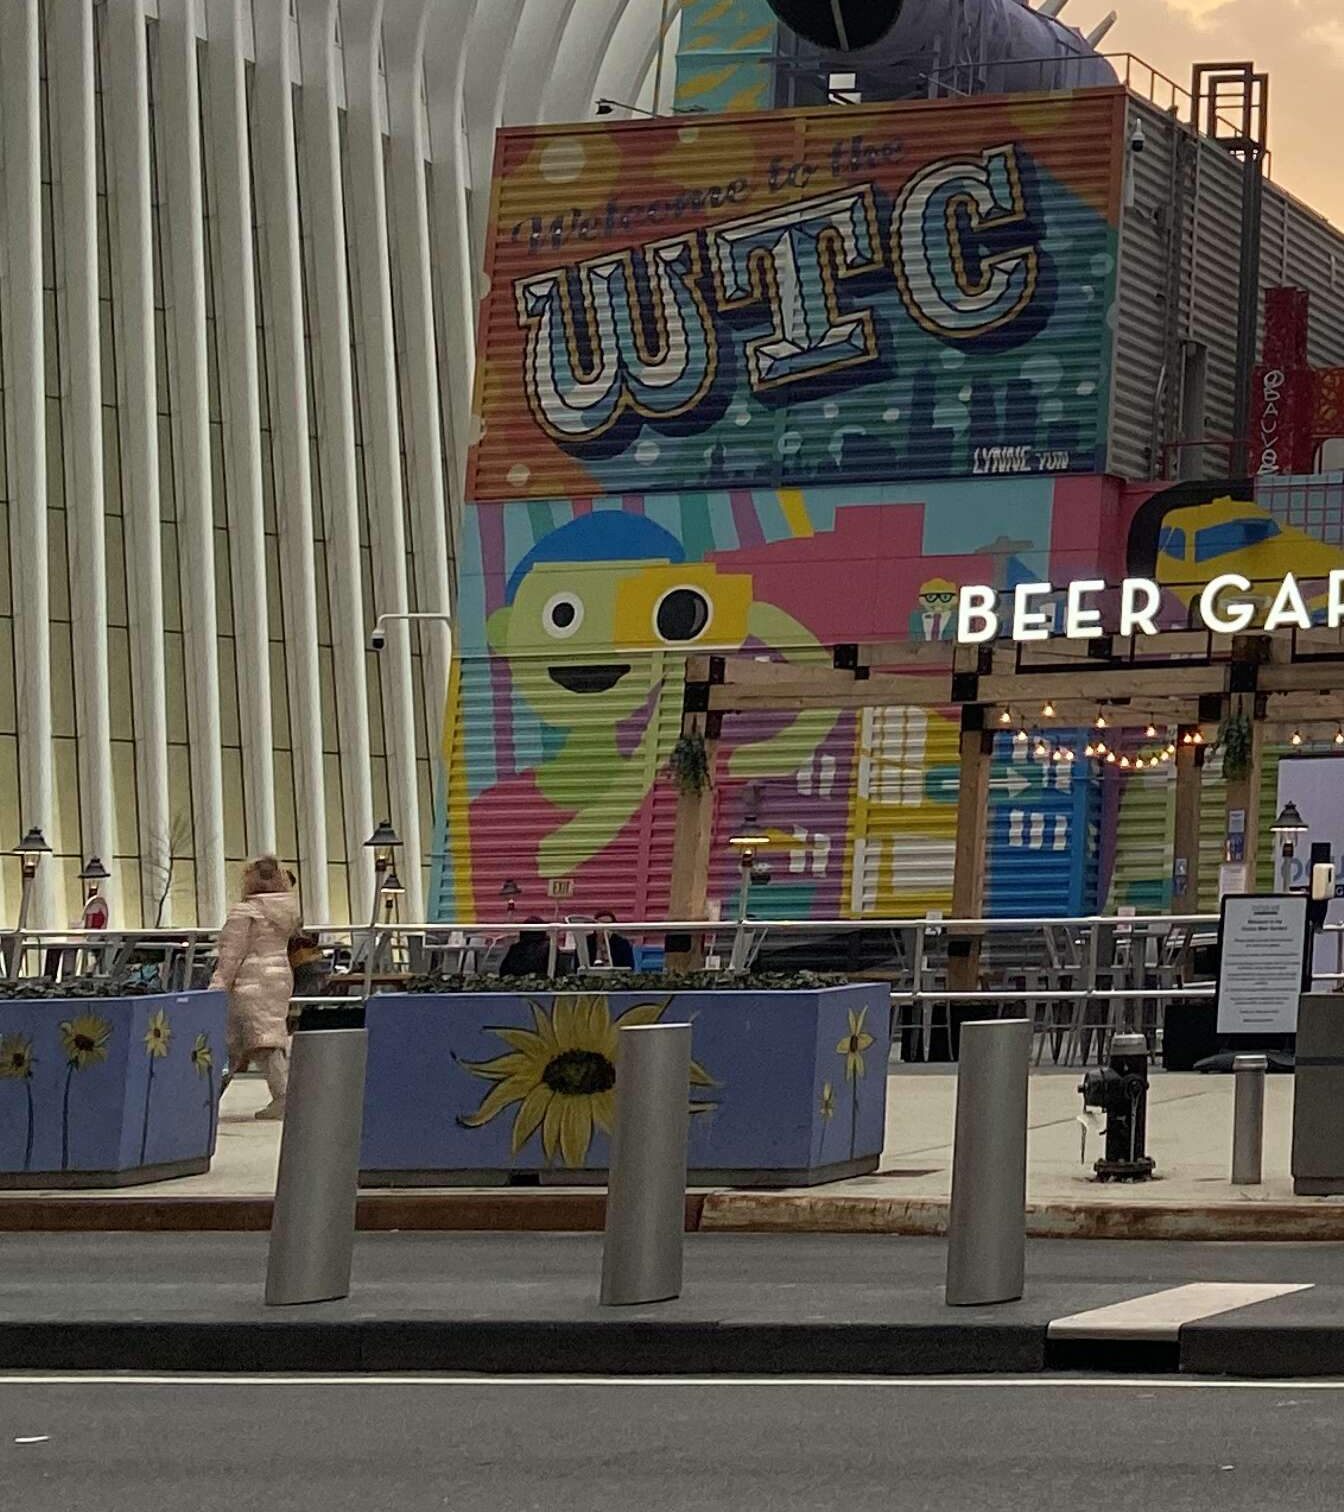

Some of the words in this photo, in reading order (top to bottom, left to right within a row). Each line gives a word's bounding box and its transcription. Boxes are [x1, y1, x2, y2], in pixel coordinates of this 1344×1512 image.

[767, 158, 817, 191] to
[515, 143, 1038, 441] WTC
[973, 446, 1031, 473] LYNNE
[956, 578, 1160, 643] BEER
